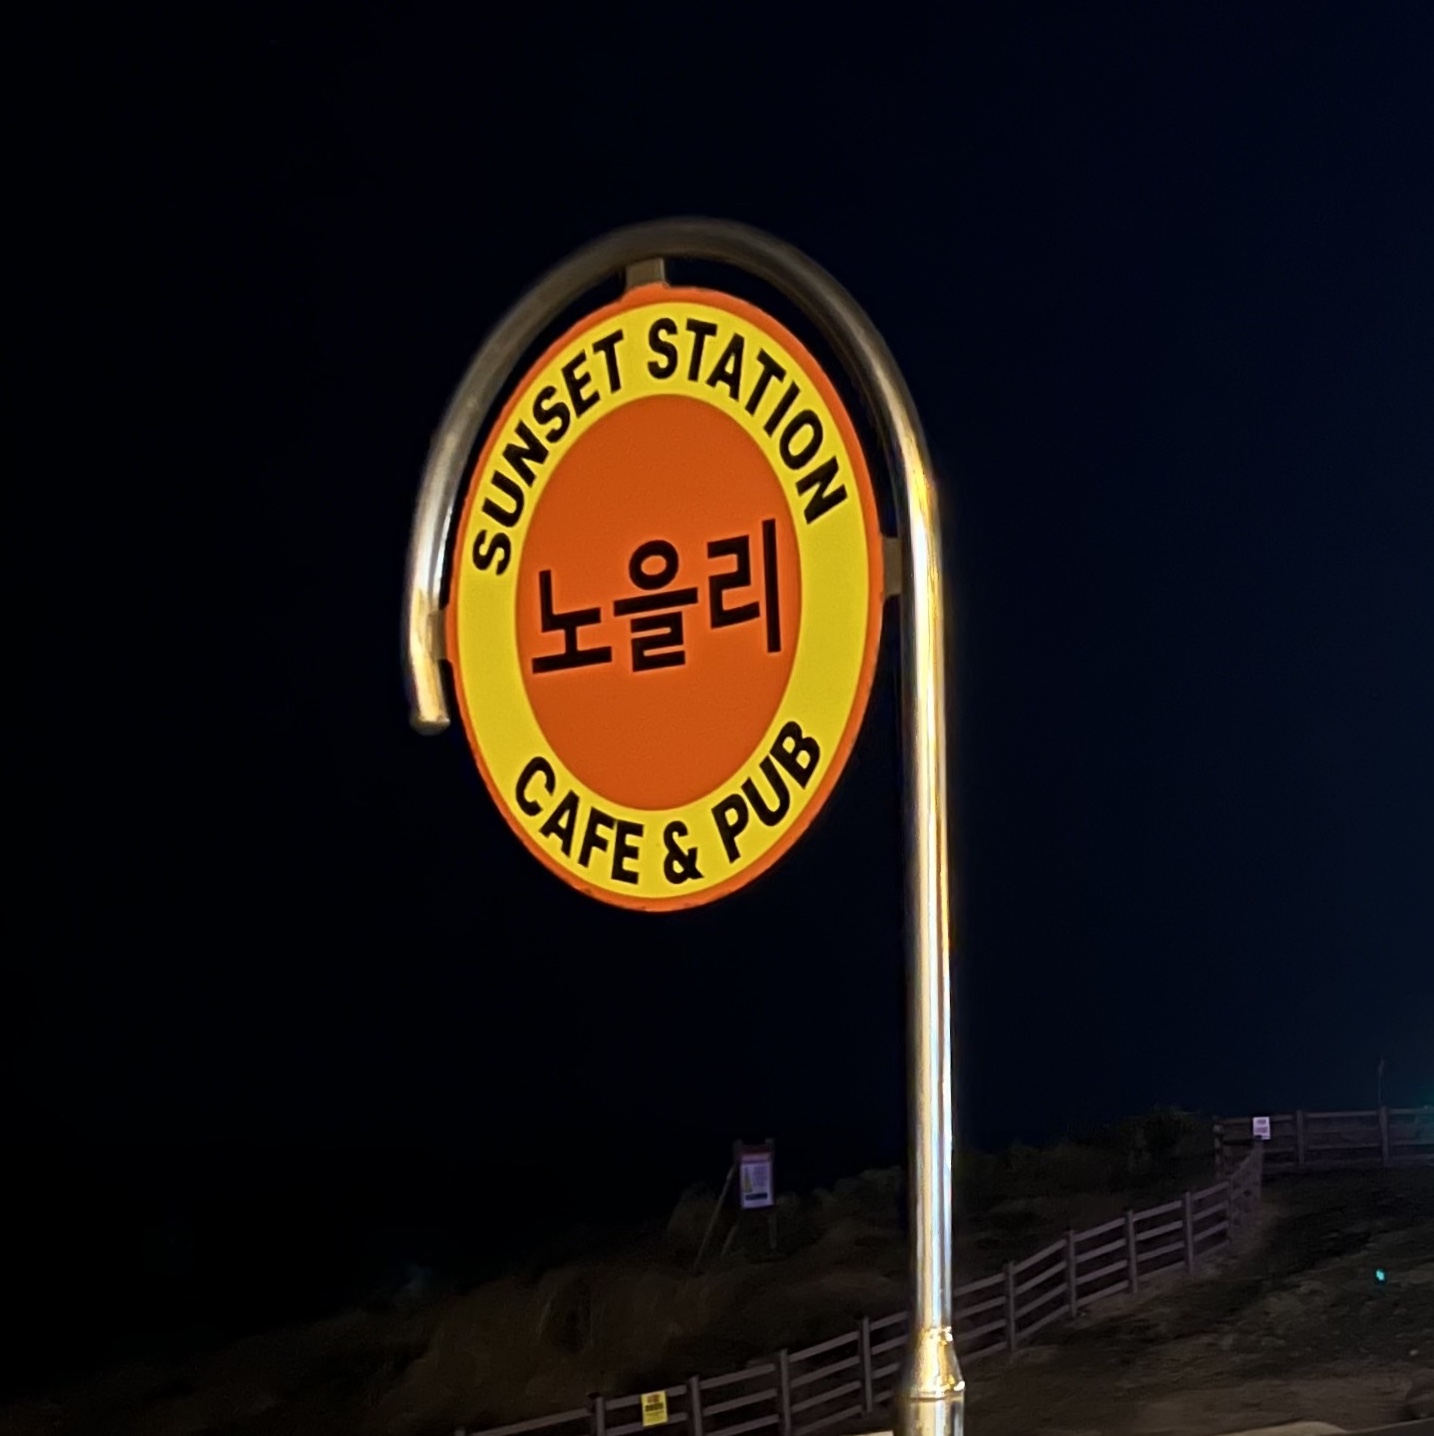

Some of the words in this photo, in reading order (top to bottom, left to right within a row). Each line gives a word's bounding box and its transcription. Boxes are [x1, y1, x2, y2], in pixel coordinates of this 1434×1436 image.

[472, 329, 626, 576] SUNSET
[647, 316, 848, 525] STATION
[531, 518, 781, 674] 노을리
[514, 756, 645, 886] CAFE
[662, 820, 705, 885] &
[710, 720, 822, 863] PUB
